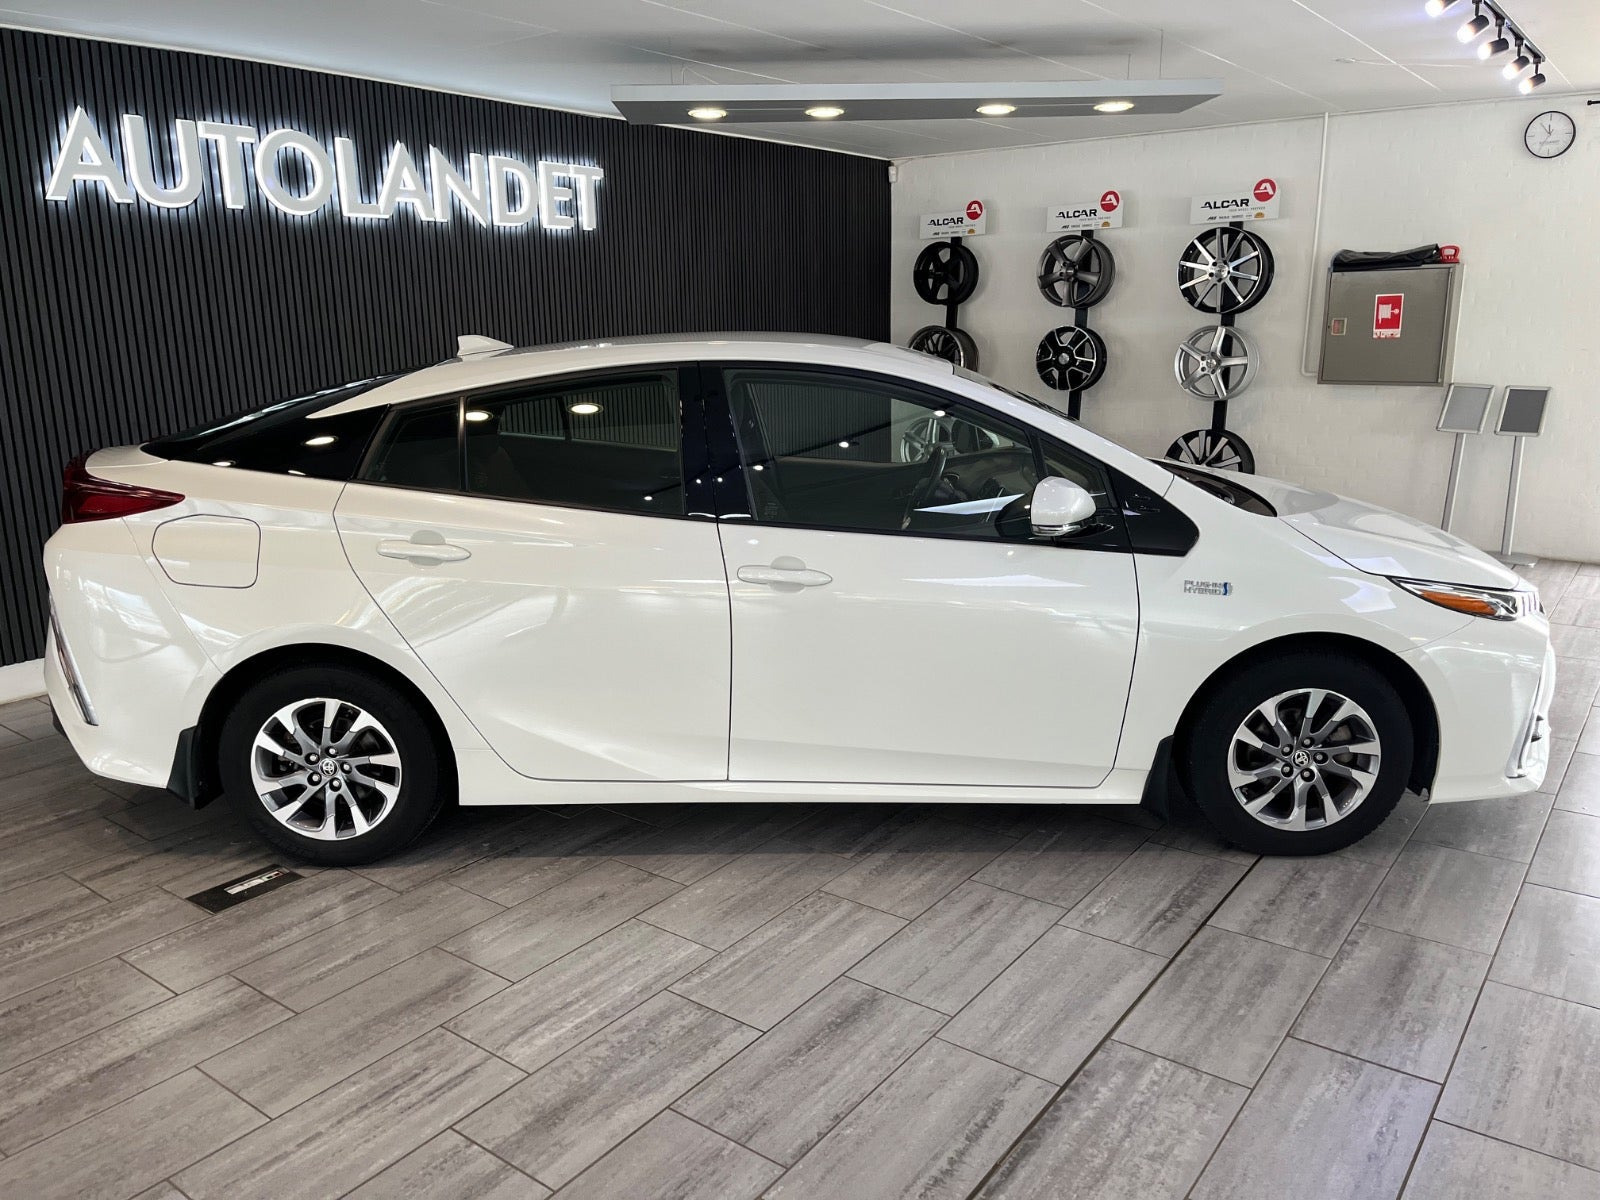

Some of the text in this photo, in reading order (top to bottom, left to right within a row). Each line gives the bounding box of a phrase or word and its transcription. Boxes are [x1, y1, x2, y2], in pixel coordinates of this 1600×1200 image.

[45, 105, 604, 230] AUTOLANDET
[1200, 198, 1250, 210] ALCAR
[1055, 208, 1098, 219] ALCAR
[927, 217, 964, 227] ALCAR
[1183, 587, 1222, 595] HYBRID
